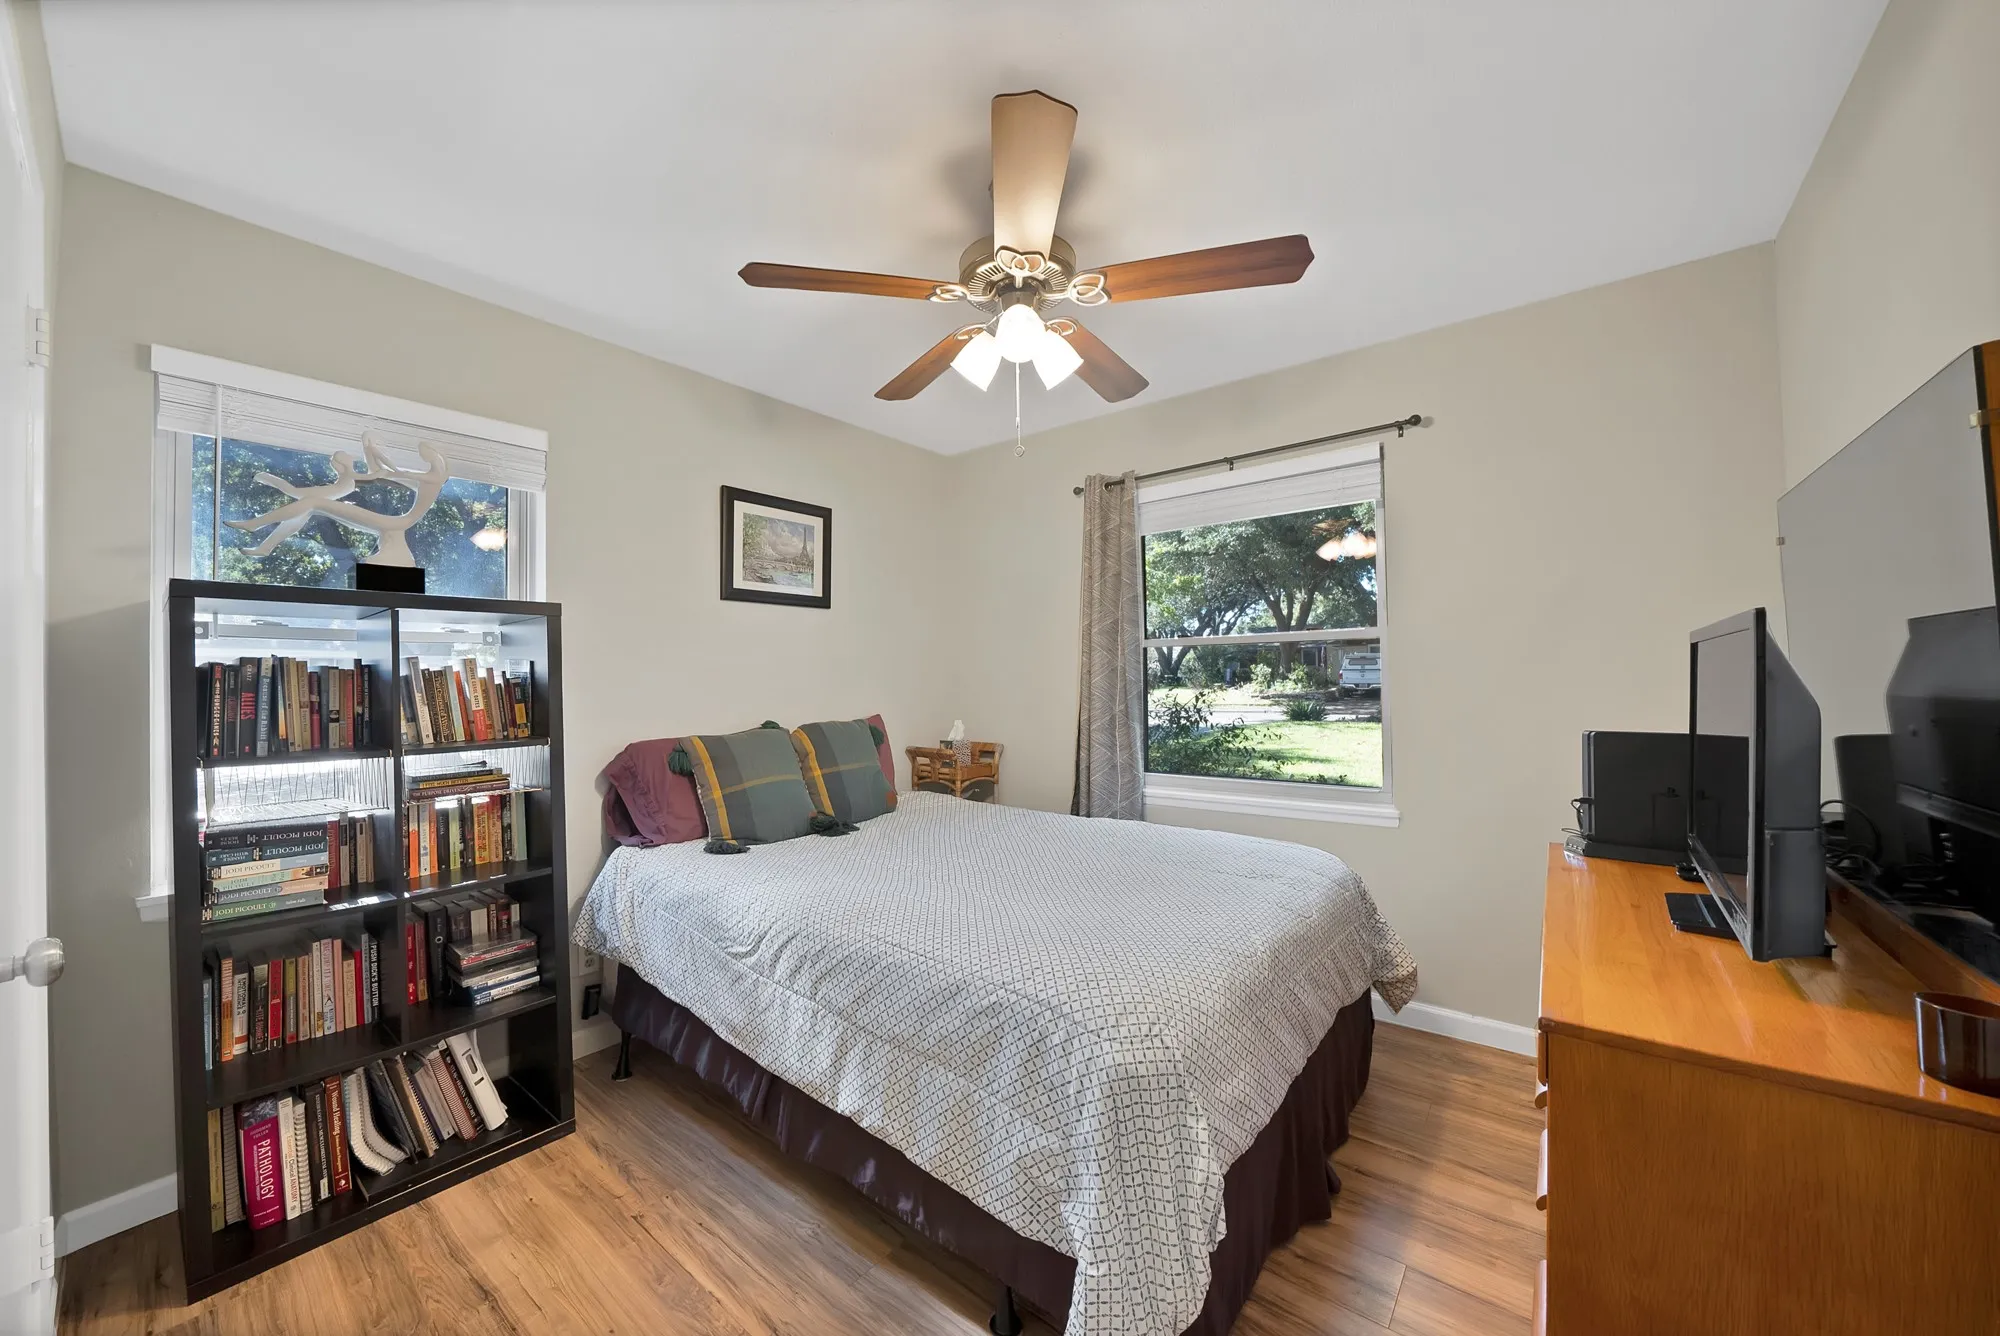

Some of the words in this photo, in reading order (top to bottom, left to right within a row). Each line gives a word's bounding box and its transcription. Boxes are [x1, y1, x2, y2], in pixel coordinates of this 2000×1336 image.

[262, 678, 270, 701] Because
[241, 692, 255, 720] ALLIES
[262, 831, 300, 841] PICOULT
[302, 829, 324, 838] JODI
[264, 845, 302, 856] PICOULT
[305, 841, 325, 850] JODI
[225, 866, 243, 875] JODI
[244, 862, 276, 873] PICOULT
[221, 892, 239, 901] JODI
[240, 887, 273, 898] PICOULT
[214, 907, 234, 917] JODI
[235, 902, 267, 913] PICOULT
[371, 982, 379, 1007] BUTTON
[331, 1090, 339, 1112] Wound
[333, 1111, 341, 1136] Healing
[257, 1139, 275, 1200] PATHOLOGY
[290, 1178, 298, 1203] ANATOMY
